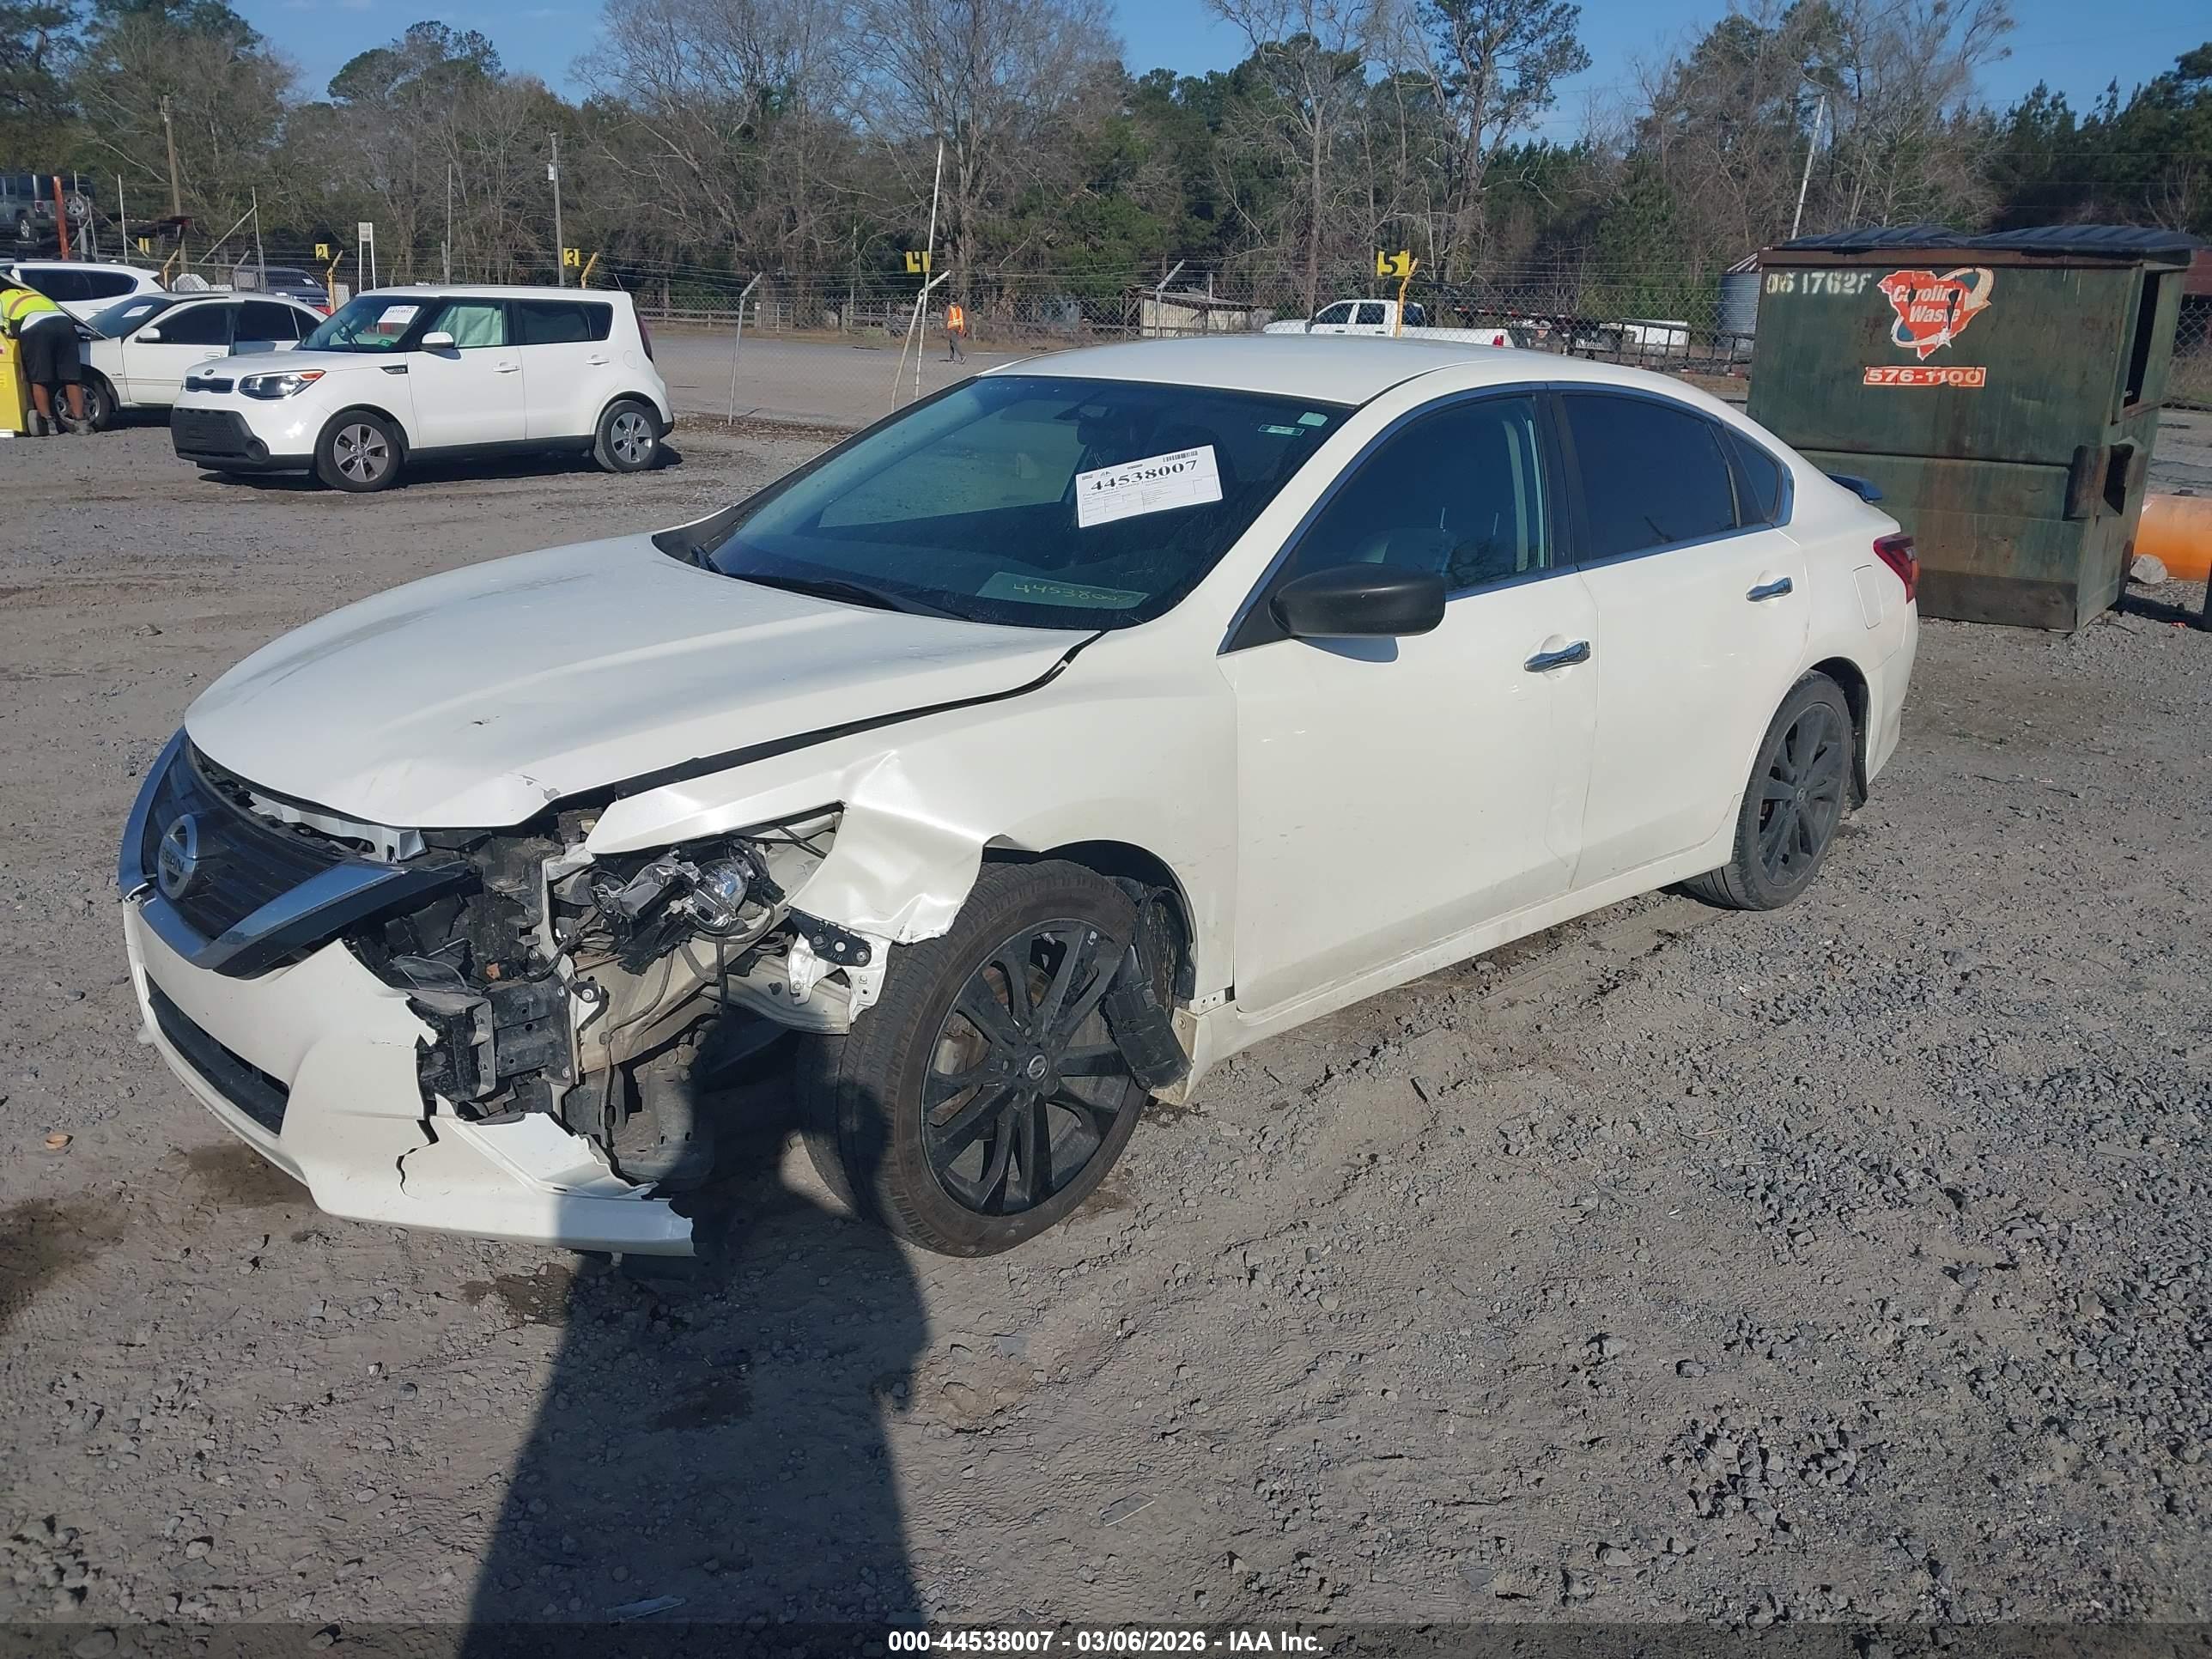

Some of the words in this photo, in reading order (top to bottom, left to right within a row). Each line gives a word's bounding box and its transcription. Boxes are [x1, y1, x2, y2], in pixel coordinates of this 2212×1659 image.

[567, 249, 575, 265] 3
[910, 251, 925, 273] 4
[1380, 250, 1401, 276] 5
[1867, 368, 1981, 383] 576-1100
[1091, 459, 1198, 491] 44538007
